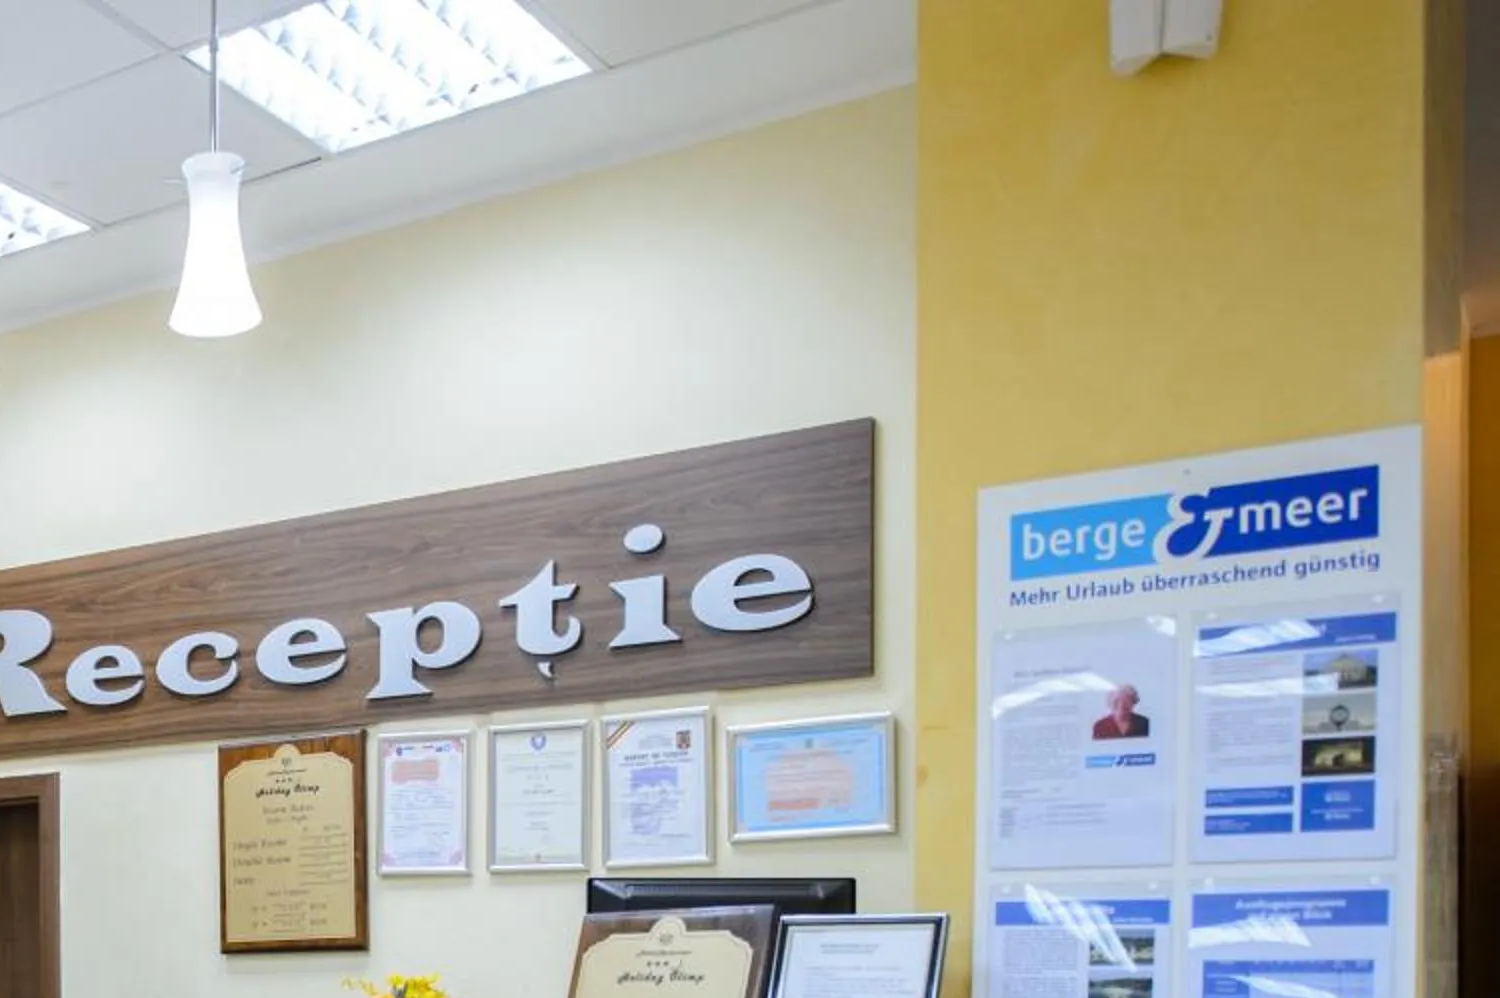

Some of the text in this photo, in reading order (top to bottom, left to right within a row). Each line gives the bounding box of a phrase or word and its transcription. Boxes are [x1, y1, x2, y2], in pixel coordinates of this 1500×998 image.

[1022, 516, 1146, 561] berge
[1238, 487, 1369, 535] meer
[1009, 550, 1381, 607] Mehr Urlaub überraschend günstig
